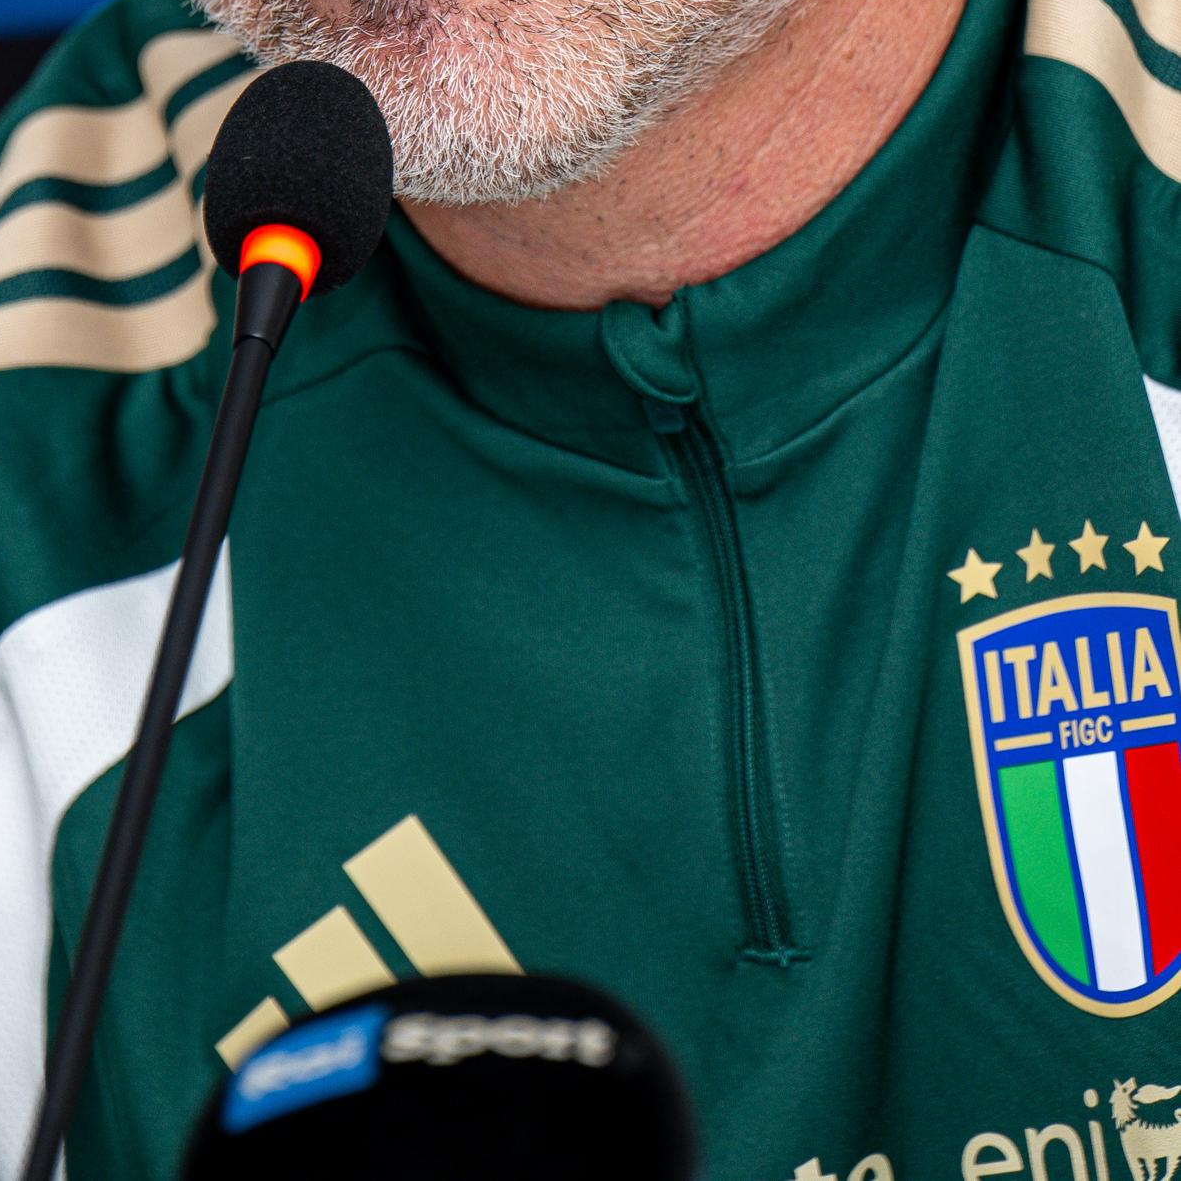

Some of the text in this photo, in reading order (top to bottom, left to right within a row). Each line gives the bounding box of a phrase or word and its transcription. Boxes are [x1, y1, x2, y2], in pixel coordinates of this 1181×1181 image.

[982, 626, 1174, 725] ITALIA
[1058, 714, 1114, 750] FIGC
[380, 1012, 615, 1068] sport
[961, 1088, 1112, 1181] eni
